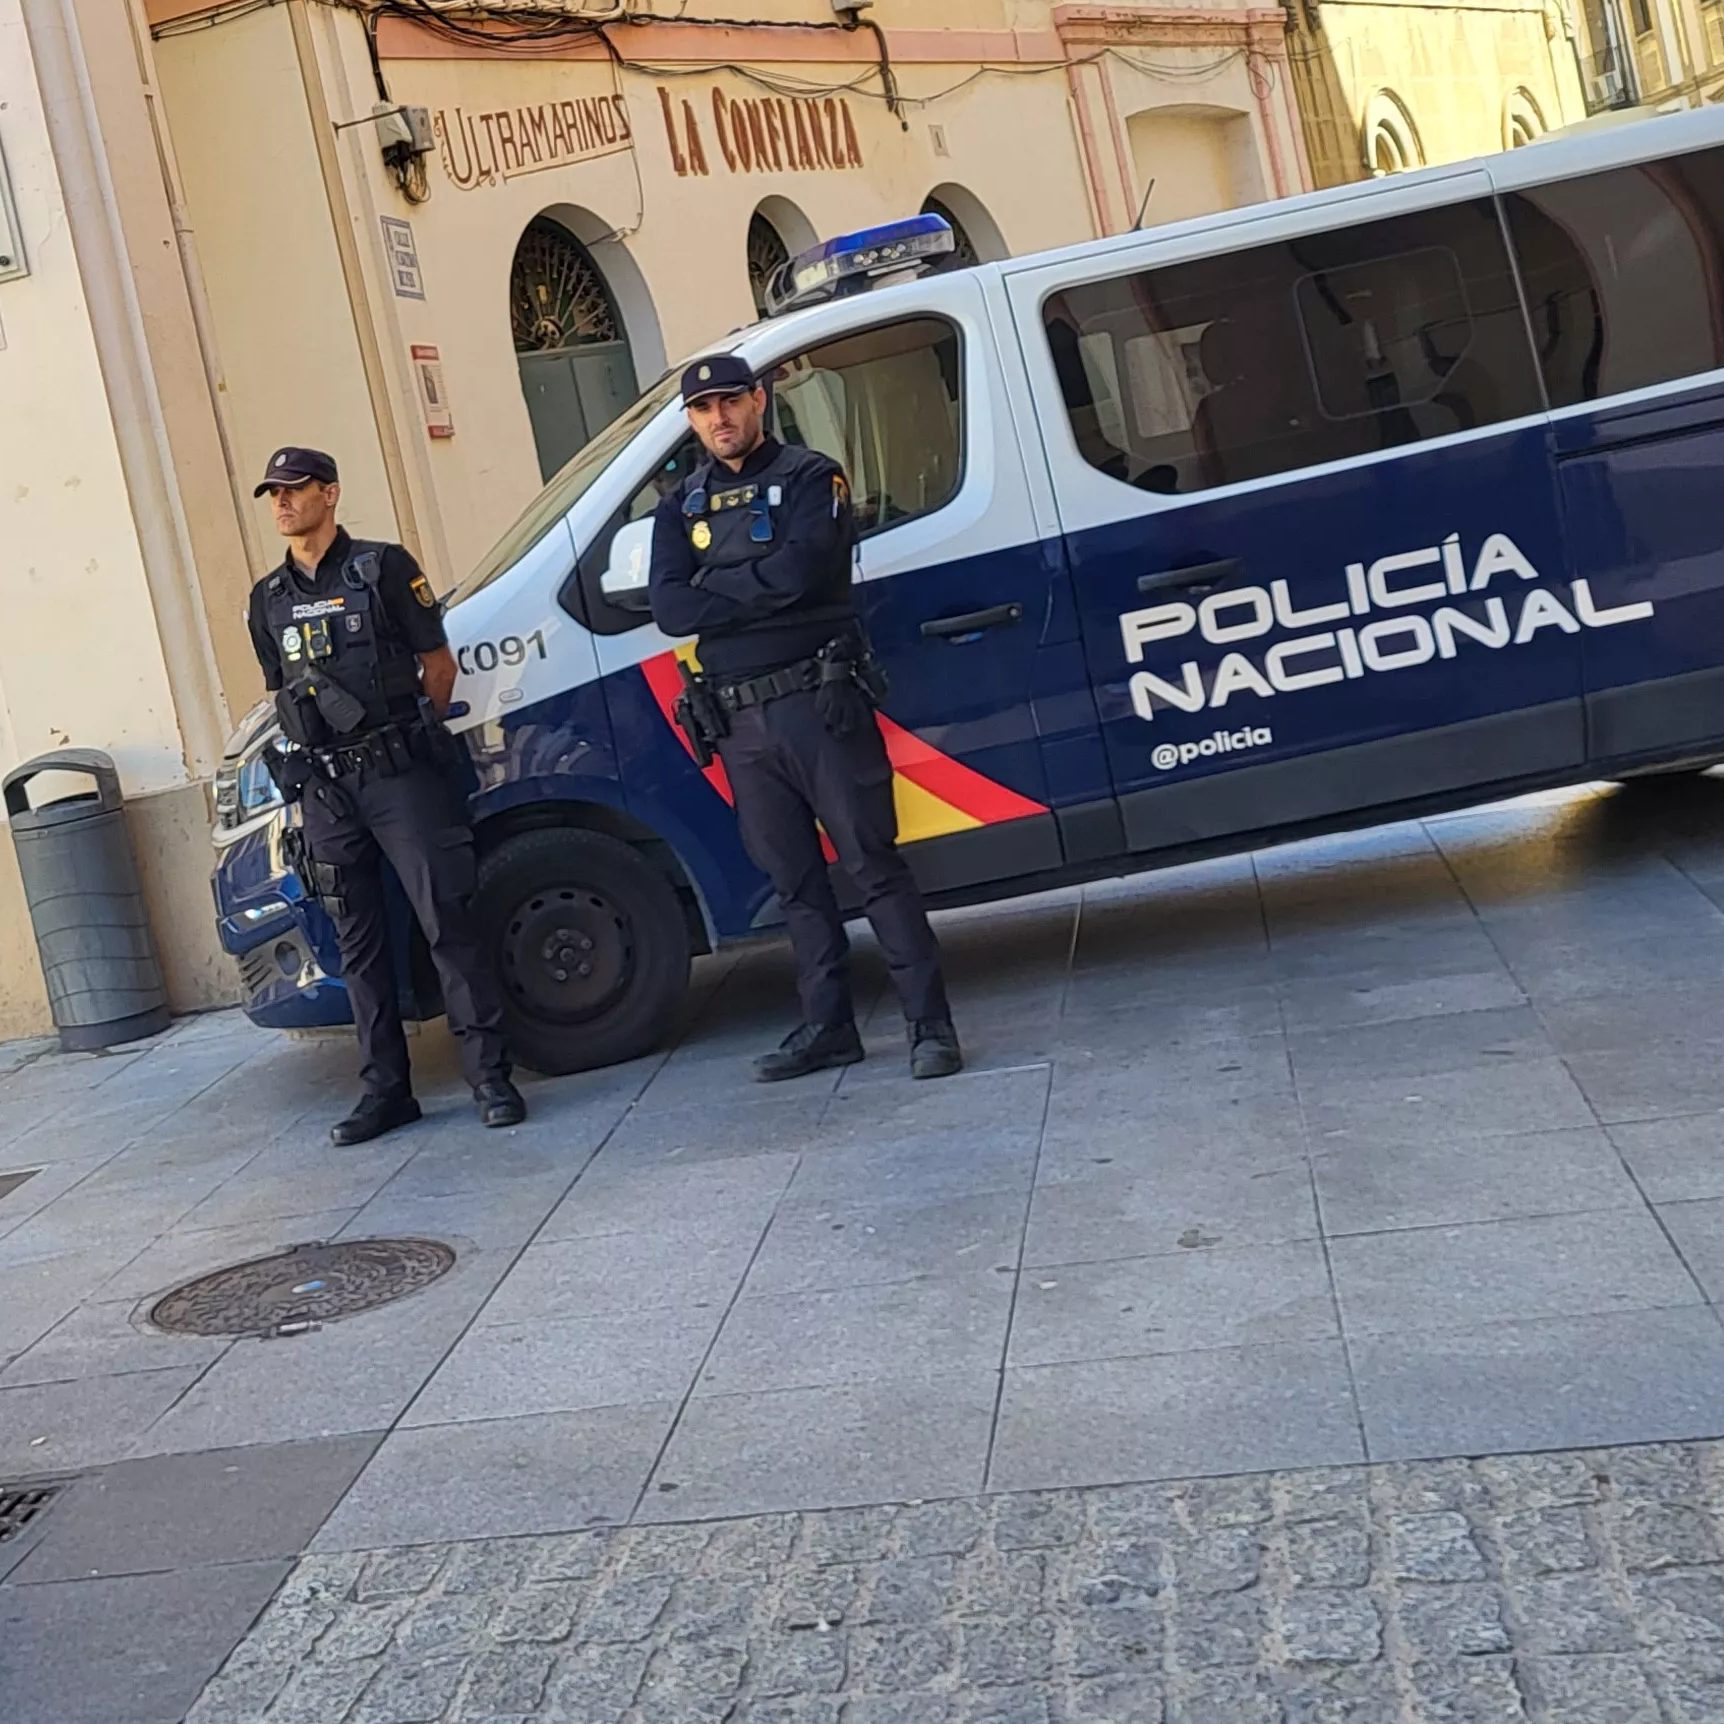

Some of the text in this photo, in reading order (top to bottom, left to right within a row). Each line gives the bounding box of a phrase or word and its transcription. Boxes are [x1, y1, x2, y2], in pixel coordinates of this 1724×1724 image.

[438, 86, 865, 185] ULTRAMARINOS LA CONFIANZA
[1119, 532, 1539, 664] POLICÍA
[1128, 578, 1654, 722] NACIONAL
[1151, 726, 1273, 770] @policia
